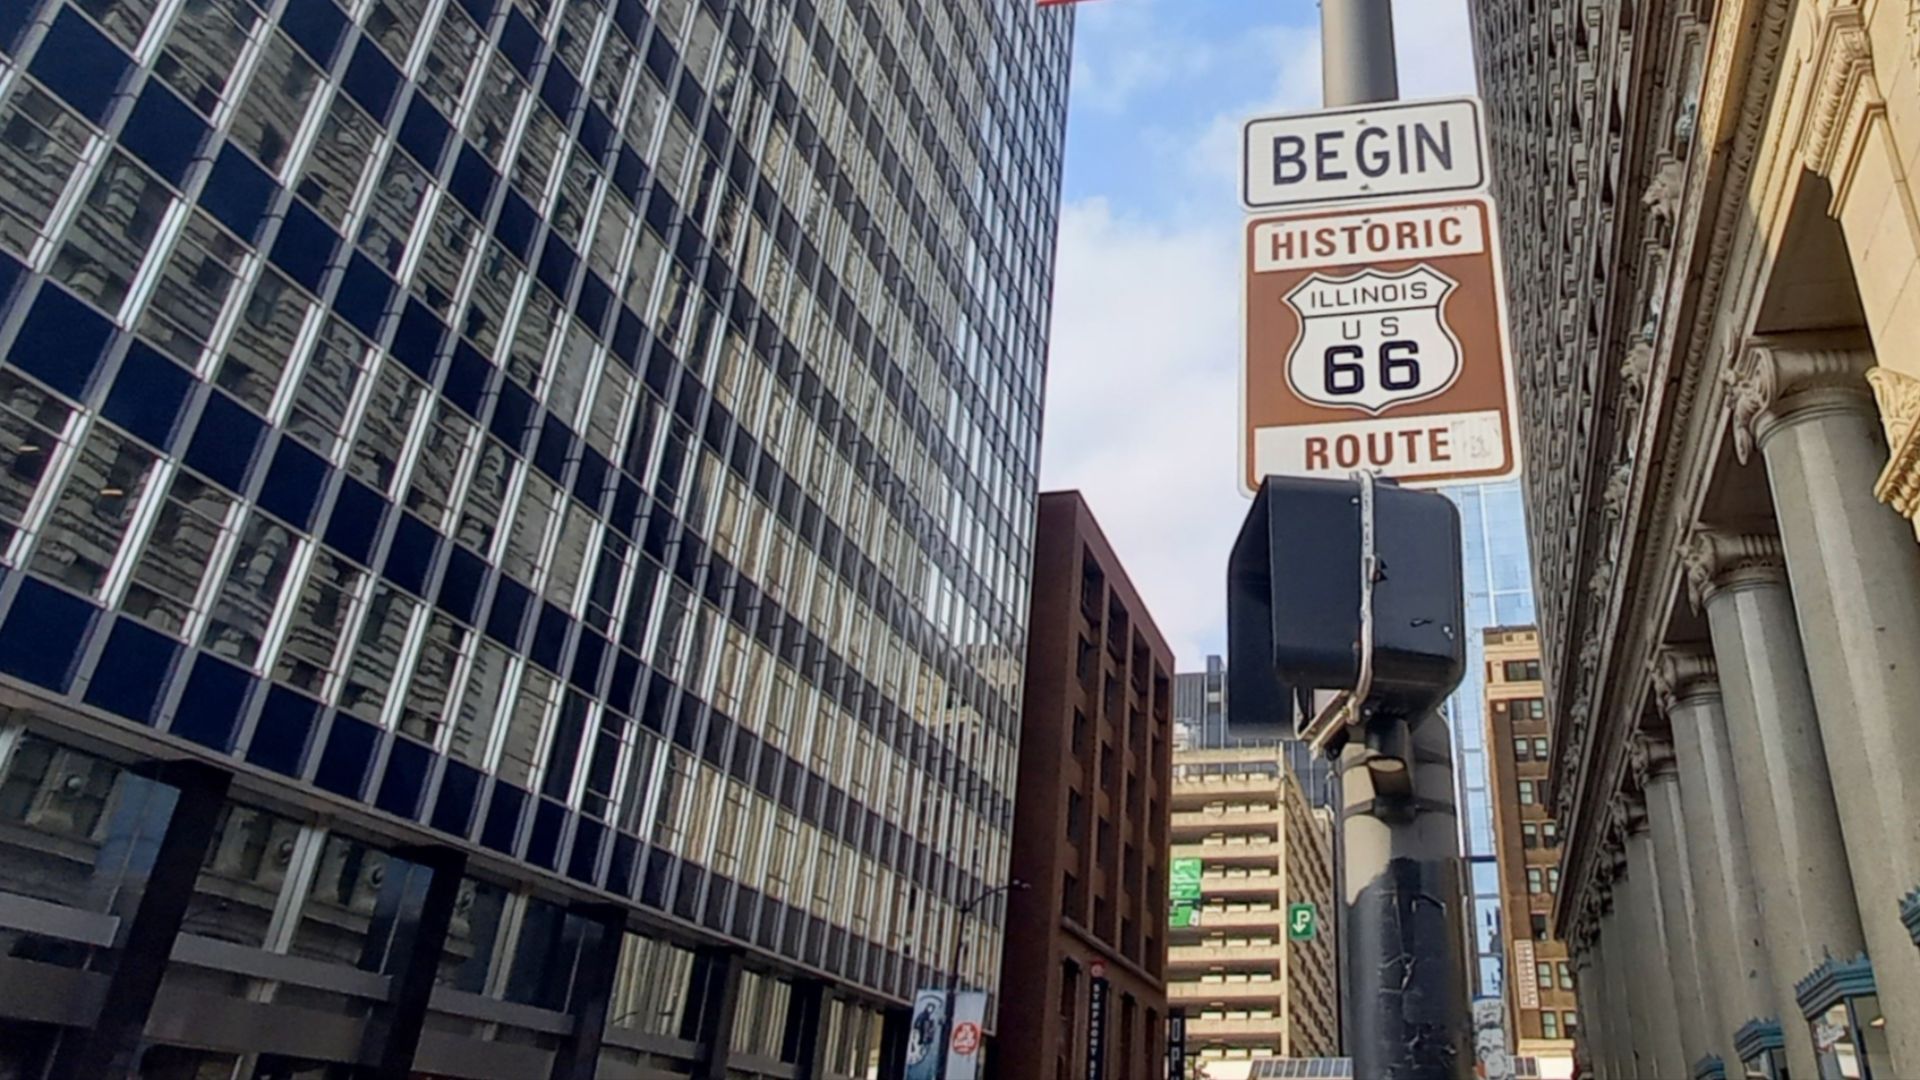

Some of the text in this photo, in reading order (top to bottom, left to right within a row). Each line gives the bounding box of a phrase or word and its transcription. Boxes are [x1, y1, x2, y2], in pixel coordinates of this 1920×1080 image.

[1272, 121, 1453, 186] BEGIN
[1271, 217, 1463, 261] HISTORIC
[1310, 281, 1428, 308] ILLINOIS
[1324, 339, 1421, 396] 66
[1304, 427, 1452, 471] ROUTE
